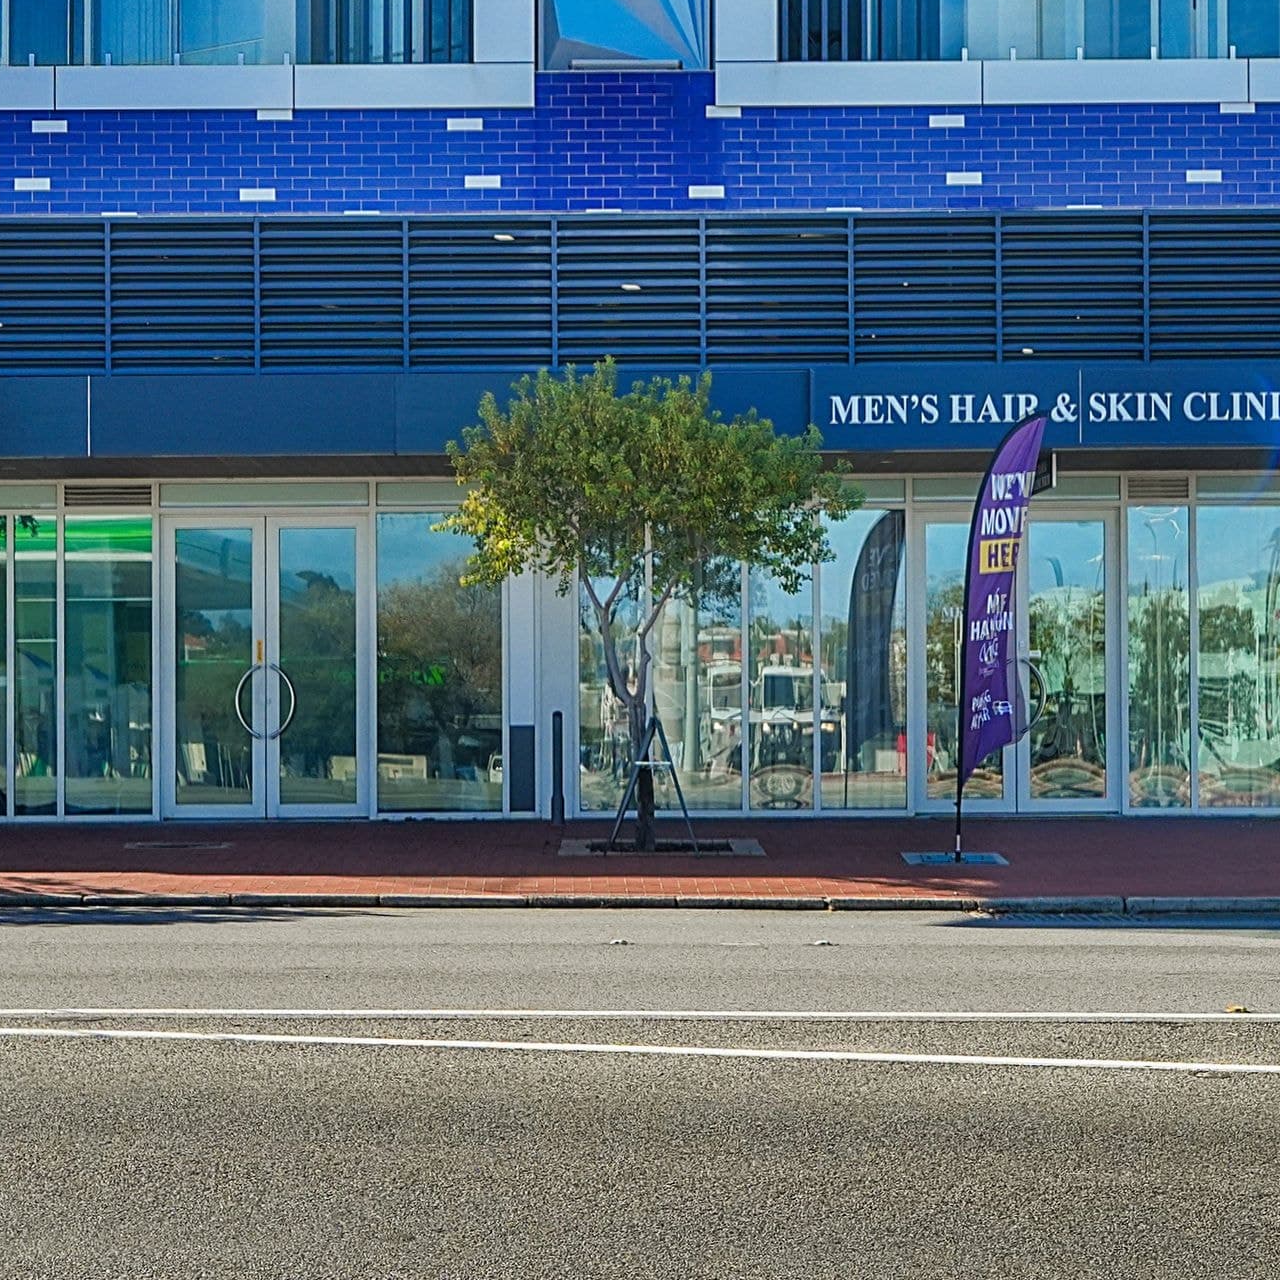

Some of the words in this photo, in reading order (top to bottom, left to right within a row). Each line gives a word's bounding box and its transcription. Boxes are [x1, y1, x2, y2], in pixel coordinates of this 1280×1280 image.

[830, 394, 940, 425] MEN'S
[1051, 392, 1078, 422] &
[1089, 391, 1173, 422] SKIN
